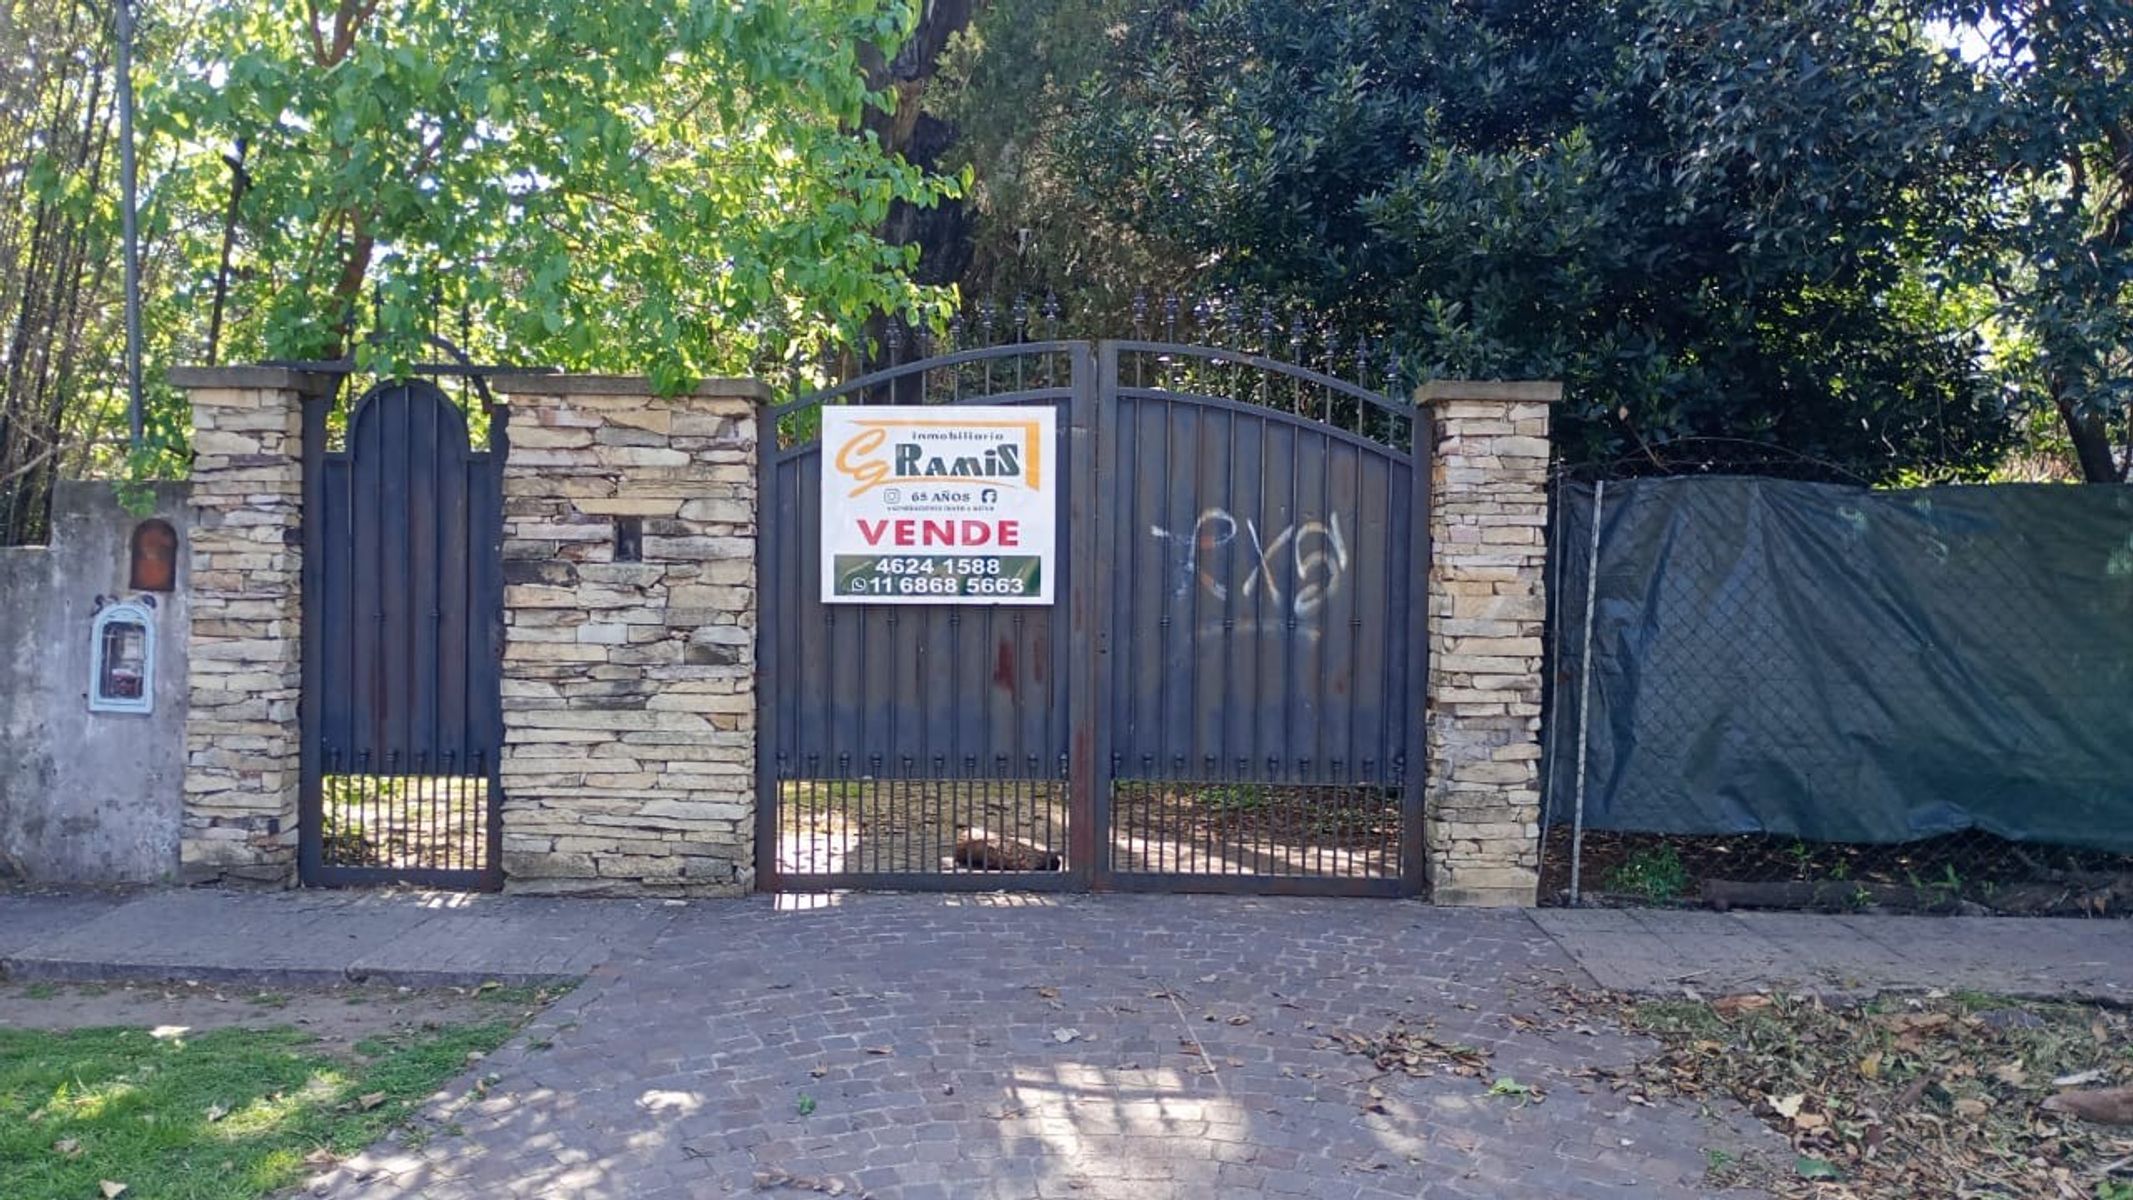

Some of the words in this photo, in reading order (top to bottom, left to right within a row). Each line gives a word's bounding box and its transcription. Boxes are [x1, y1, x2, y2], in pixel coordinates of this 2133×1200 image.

[911, 431, 1004, 441] inmobiliaria
[911, 492, 928, 502] 65
[932, 488, 971, 502] AÑOS
[856, 519, 1020, 547] VENDE
[875, 558, 935, 574] 4624
[942, 557, 1000, 574] 1588
[871, 578, 892, 594] 11
[899, 578, 959, 594] 6868
[966, 578, 1025, 594] 5663
